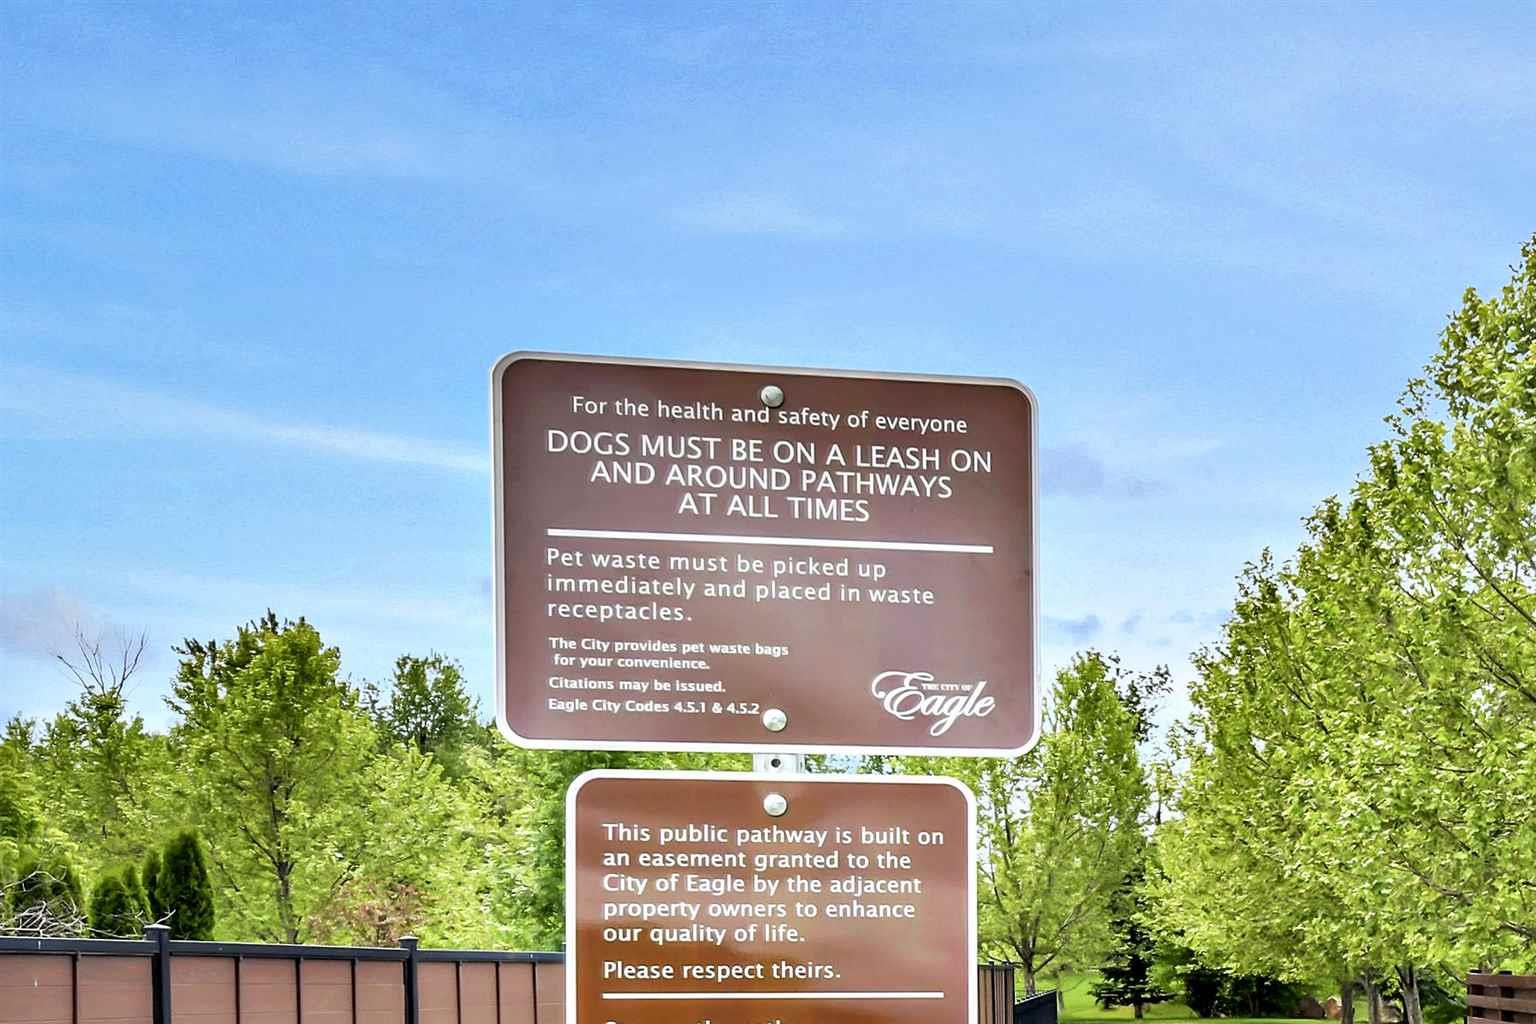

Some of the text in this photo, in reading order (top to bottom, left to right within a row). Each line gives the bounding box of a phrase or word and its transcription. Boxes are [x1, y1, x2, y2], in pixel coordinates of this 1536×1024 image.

[573, 396, 967, 435] For the health and safety of everyone
[548, 430, 991, 472] DOGS MUST BE ON A LEASH ON
[591, 461, 952, 498] AND AROUND PATHWAYS
[678, 492, 869, 521] AT ALL TIMES
[548, 548, 885, 581] Pet waste must be picked up
[548, 574, 933, 604] immediately and placed in waste
[548, 598, 691, 622] receptacles.
[549, 637, 788, 657] The City provides pet waste bags
[554, 654, 710, 669] for your convenience.
[549, 677, 726, 692] Citations may be issued.
[549, 698, 759, 714] Eagle City Codes 4.5.1 & 4.5.2
[872, 671, 996, 736] Eagle
[602, 823, 943, 847] This public pathway is built on
[603, 851, 911, 871] an easement granted to the
[603, 874, 921, 897] City of Eagle by the adjacent
[604, 901, 915, 920] property owners to enhance
[603, 924, 805, 945] our quality of life.
[602, 961, 840, 982] Please respect theirs.
